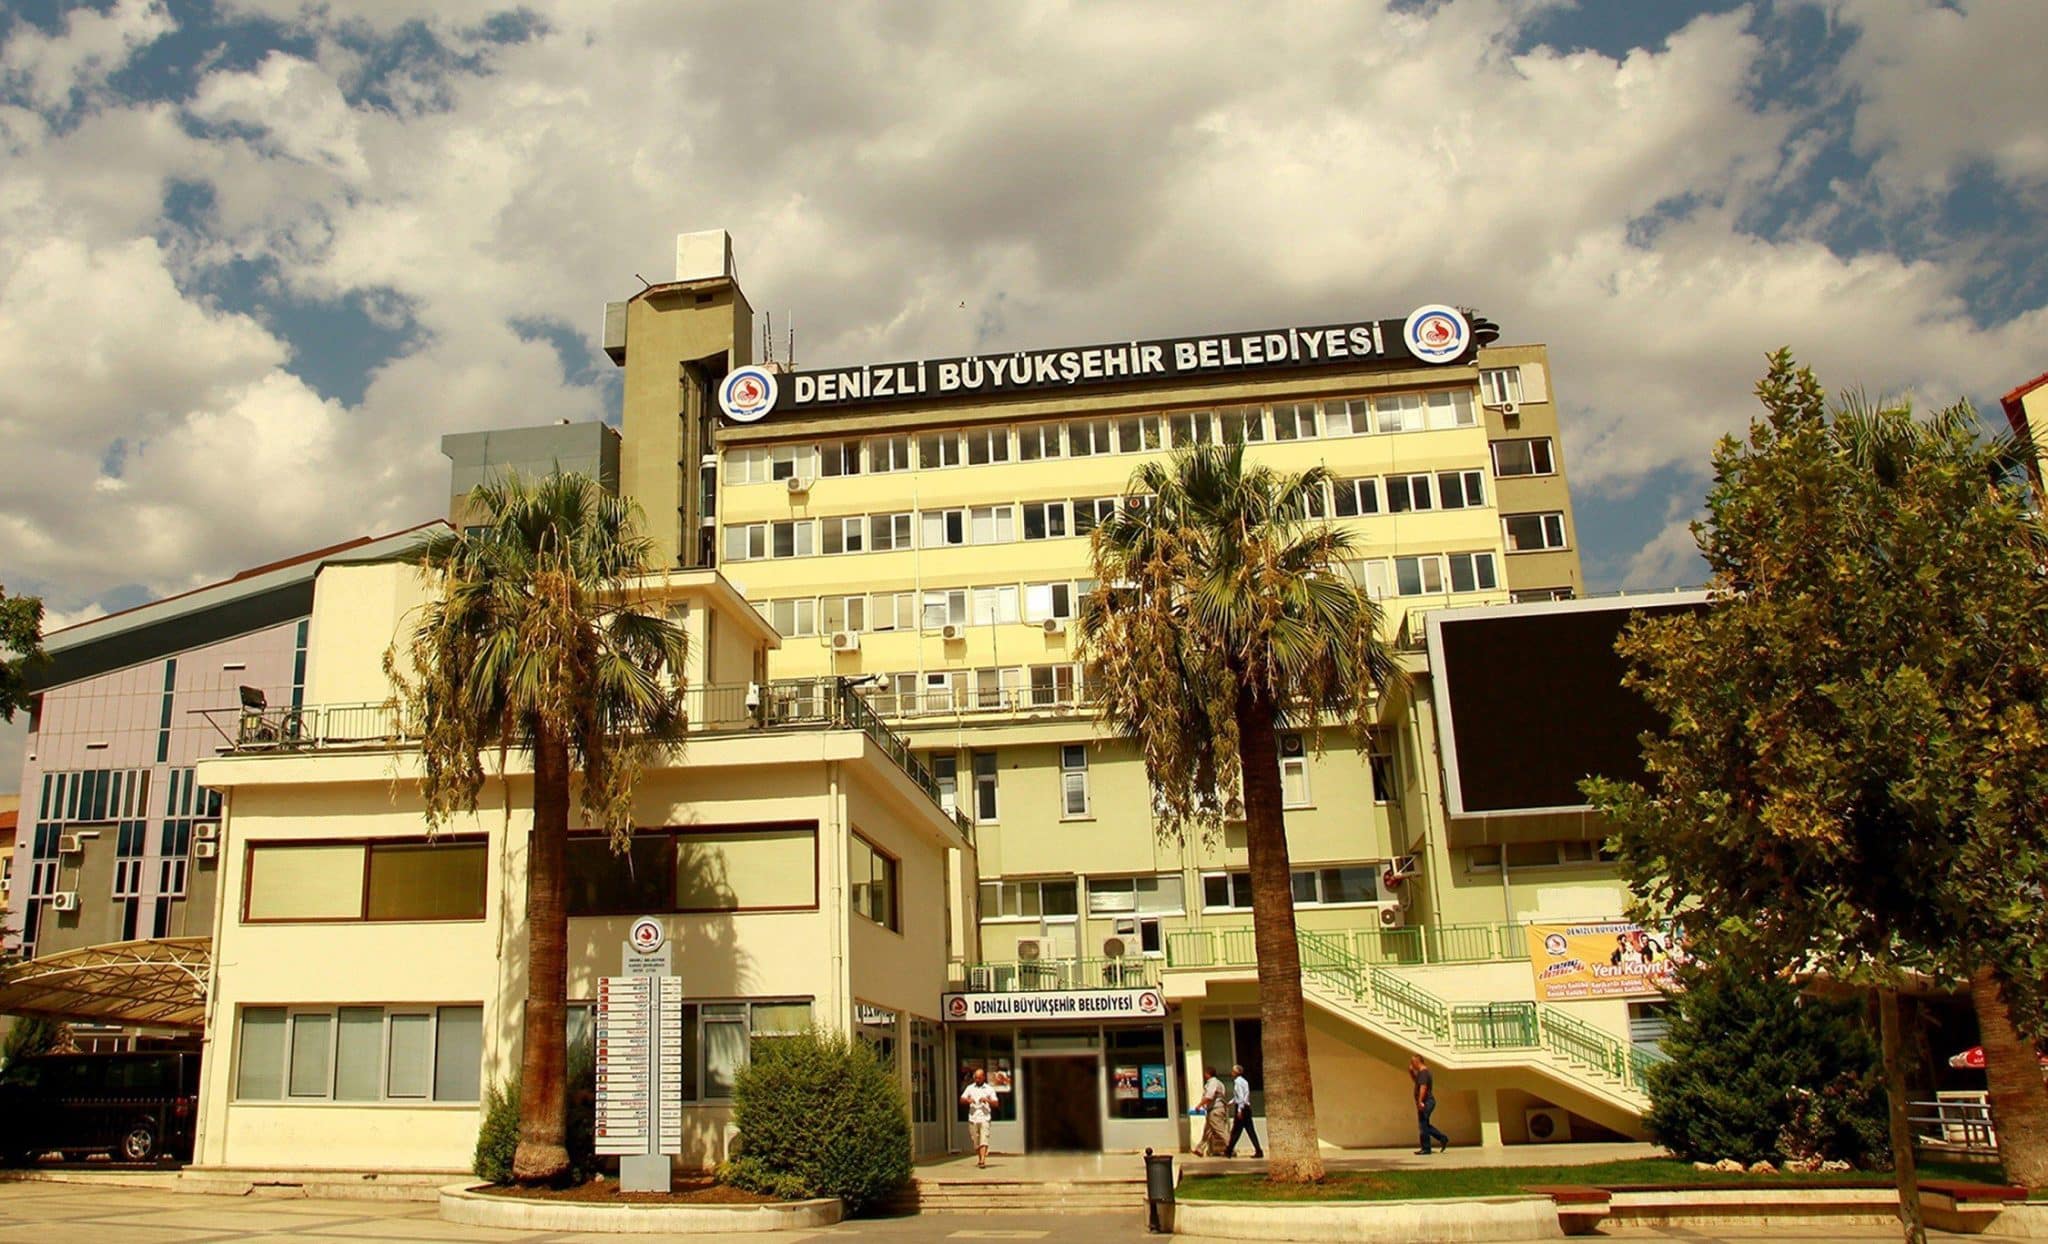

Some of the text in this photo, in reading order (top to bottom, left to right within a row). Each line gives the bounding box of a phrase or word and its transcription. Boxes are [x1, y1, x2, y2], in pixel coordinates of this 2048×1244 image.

[795, 321, 1385, 403] DENİZLİ BÜYÜKŞEHİR BELEDİYESİ
[1592, 962, 1622, 977] Yeni
[974, 994, 1133, 1016] DENİZLİ BÜYÜKŞEHİR BELEDİYESİ
